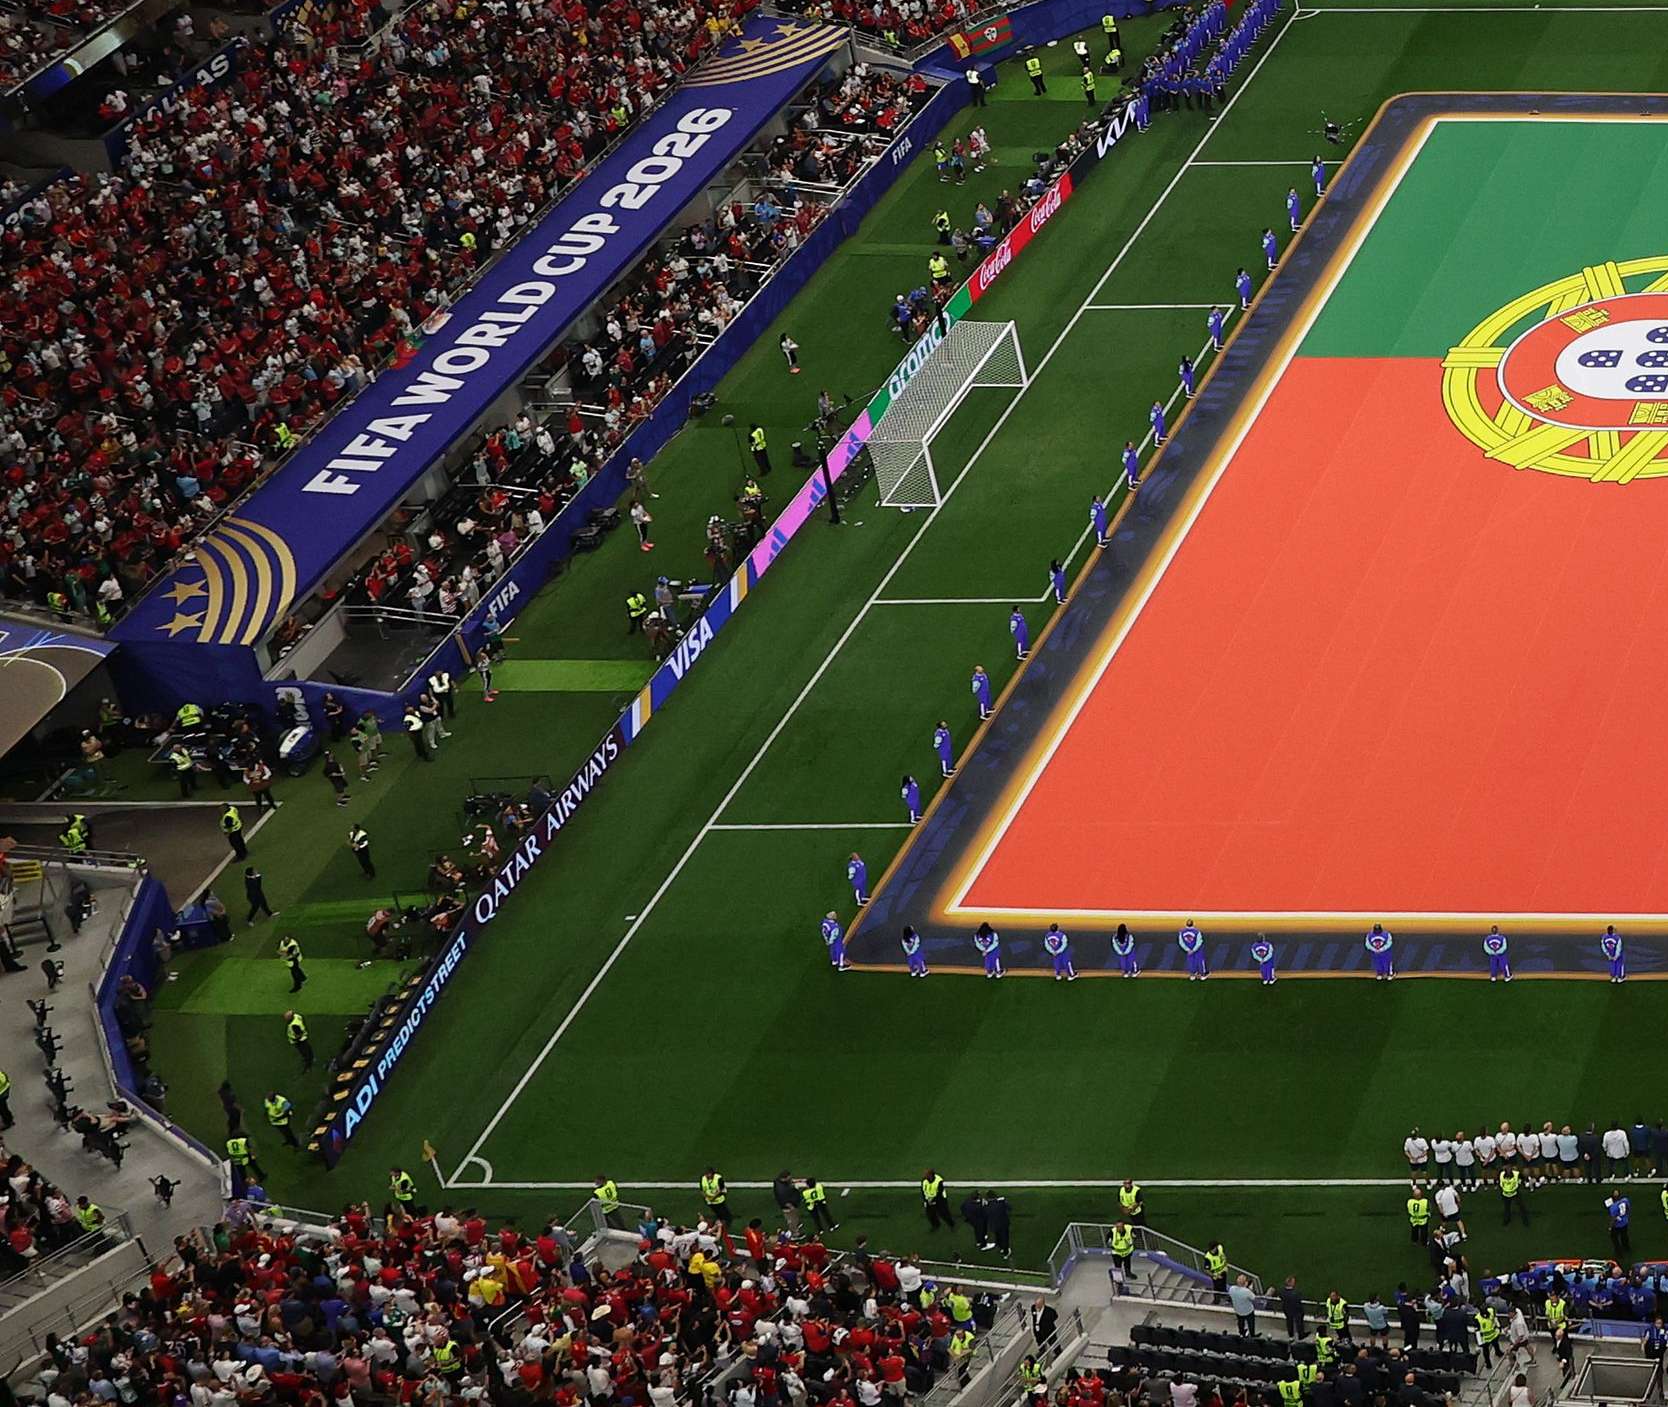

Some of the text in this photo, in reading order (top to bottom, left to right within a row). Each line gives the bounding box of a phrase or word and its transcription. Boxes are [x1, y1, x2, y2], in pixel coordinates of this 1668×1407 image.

[891, 137, 912, 165] FIFA
[300, 107, 732, 495] FIFA WORLD CUP 2026
[488, 581, 520, 618] FIFA
[665, 616, 715, 682] VISA
[474, 732, 620, 926] QATAR AIRWAYS
[344, 932, 468, 1138] ADI PREDICTSTREET
